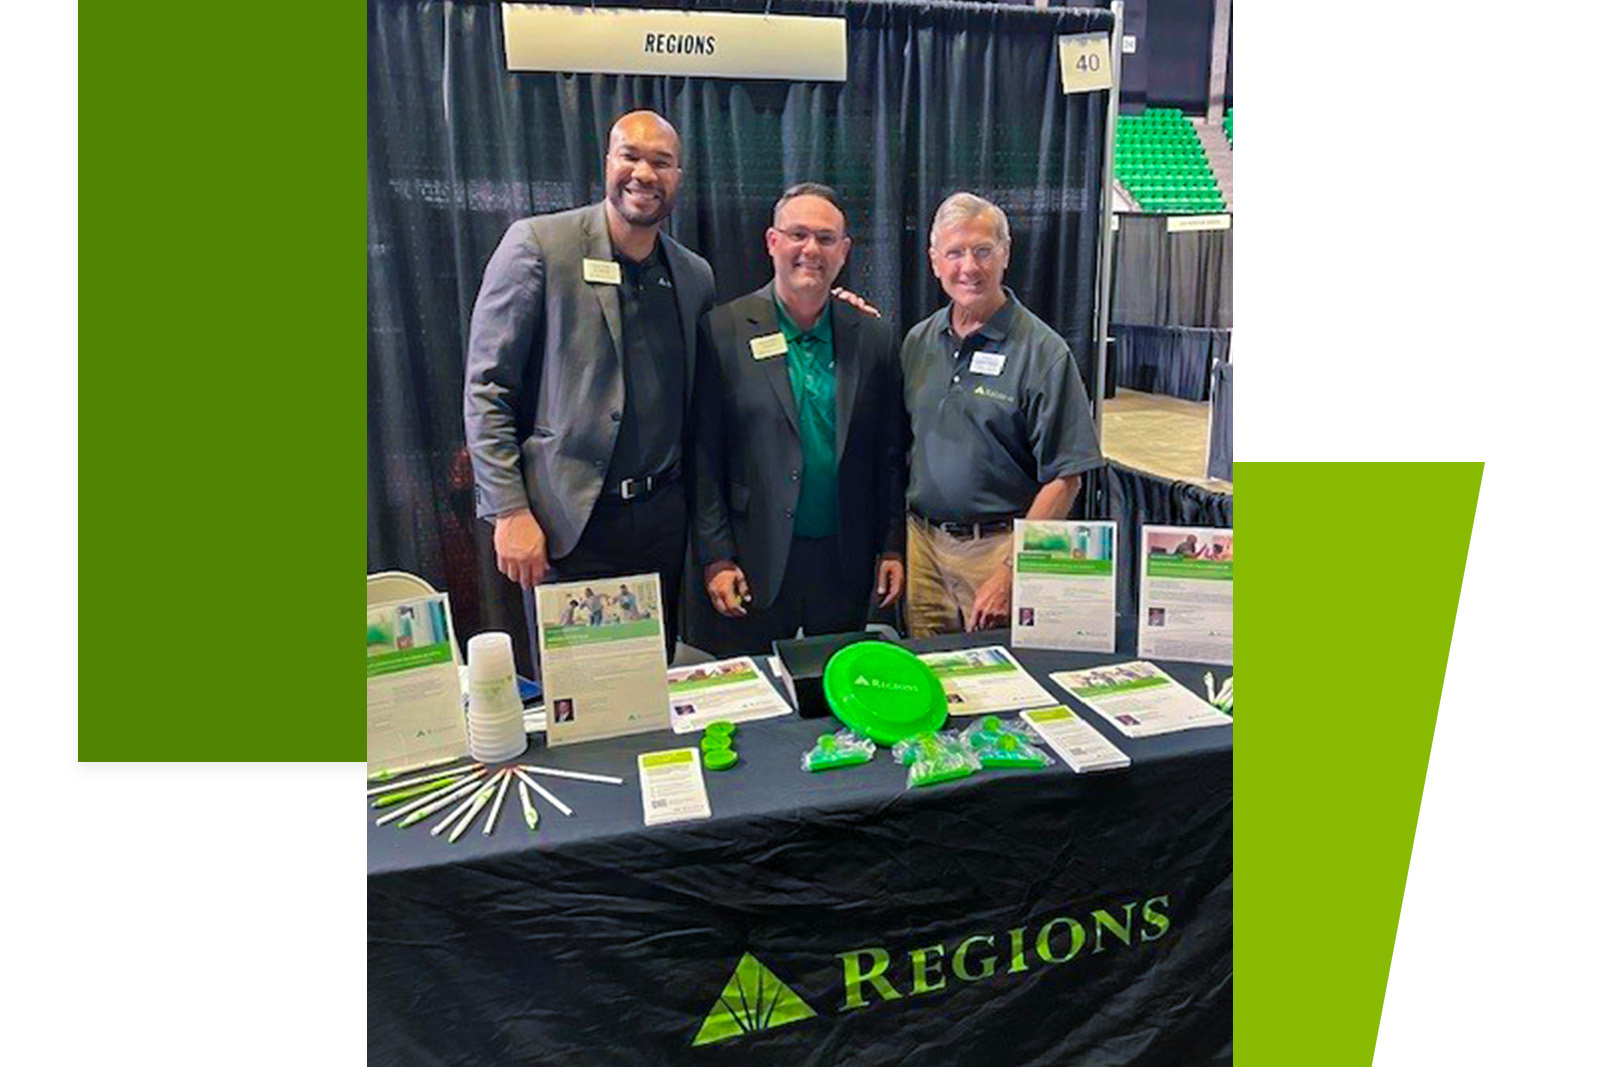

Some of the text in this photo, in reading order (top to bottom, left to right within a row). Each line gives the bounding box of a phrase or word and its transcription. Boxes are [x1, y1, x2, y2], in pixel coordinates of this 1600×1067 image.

[644, 33, 716, 56] REGIONS
[1076, 53, 1100, 72] 40
[834, 895, 1172, 1012] REGIONS
